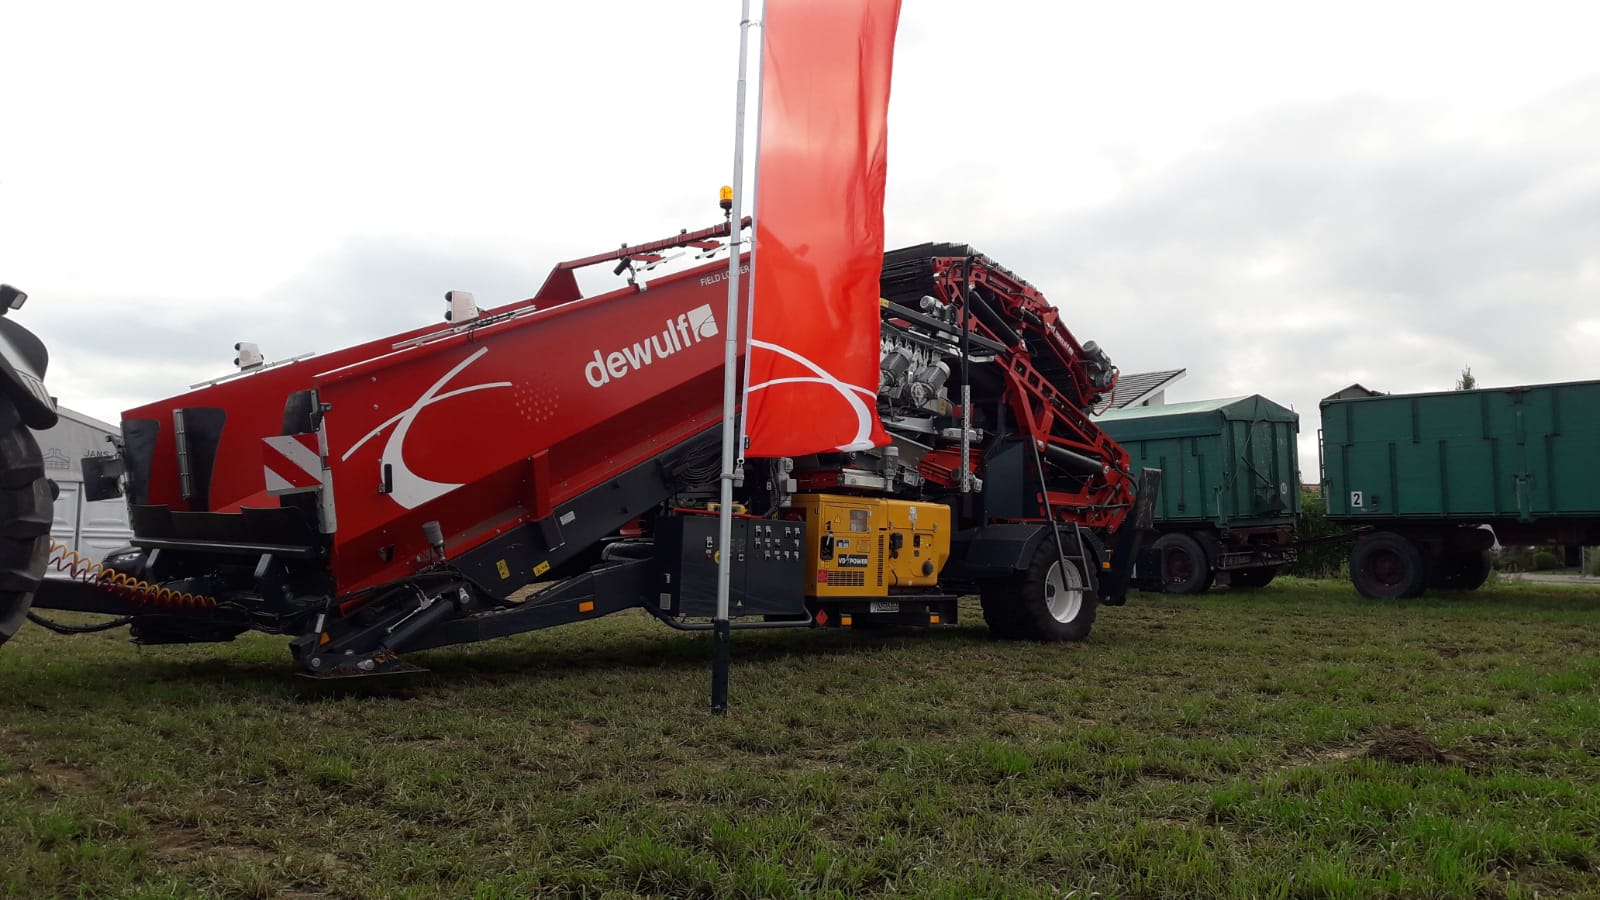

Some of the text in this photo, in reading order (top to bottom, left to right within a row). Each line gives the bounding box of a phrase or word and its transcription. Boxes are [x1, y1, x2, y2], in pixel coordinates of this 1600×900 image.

[700, 265, 750, 287] FIELD LOER
[585, 313, 692, 388] dewulf
[1353, 493, 1360, 505] 2
